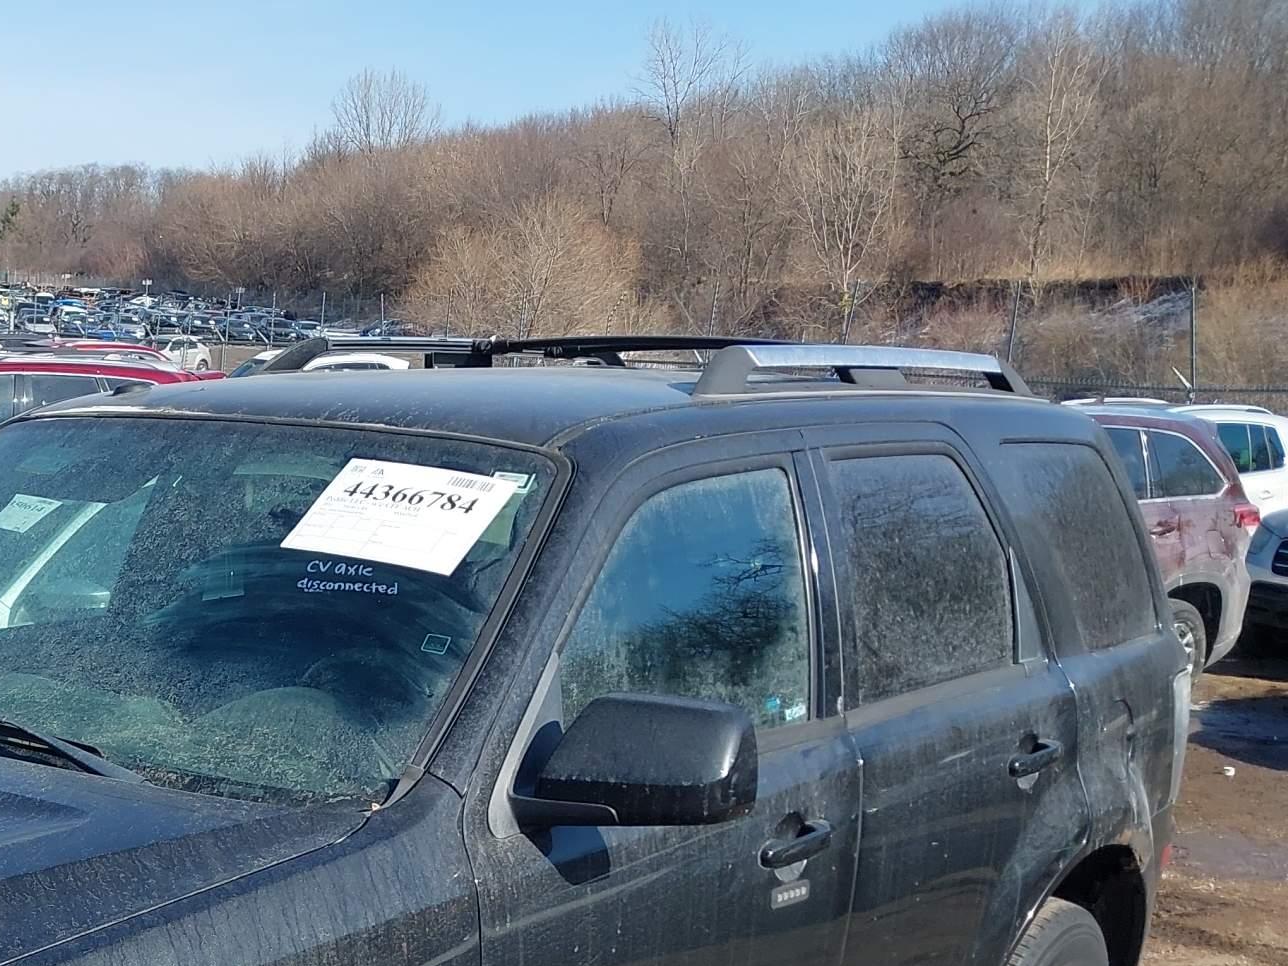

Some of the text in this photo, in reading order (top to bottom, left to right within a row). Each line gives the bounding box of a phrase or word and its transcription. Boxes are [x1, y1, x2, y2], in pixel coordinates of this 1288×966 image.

[343, 481, 480, 514] 44366784
[306, 560, 332, 572] CV
[296, 578, 398, 595] disconnected
